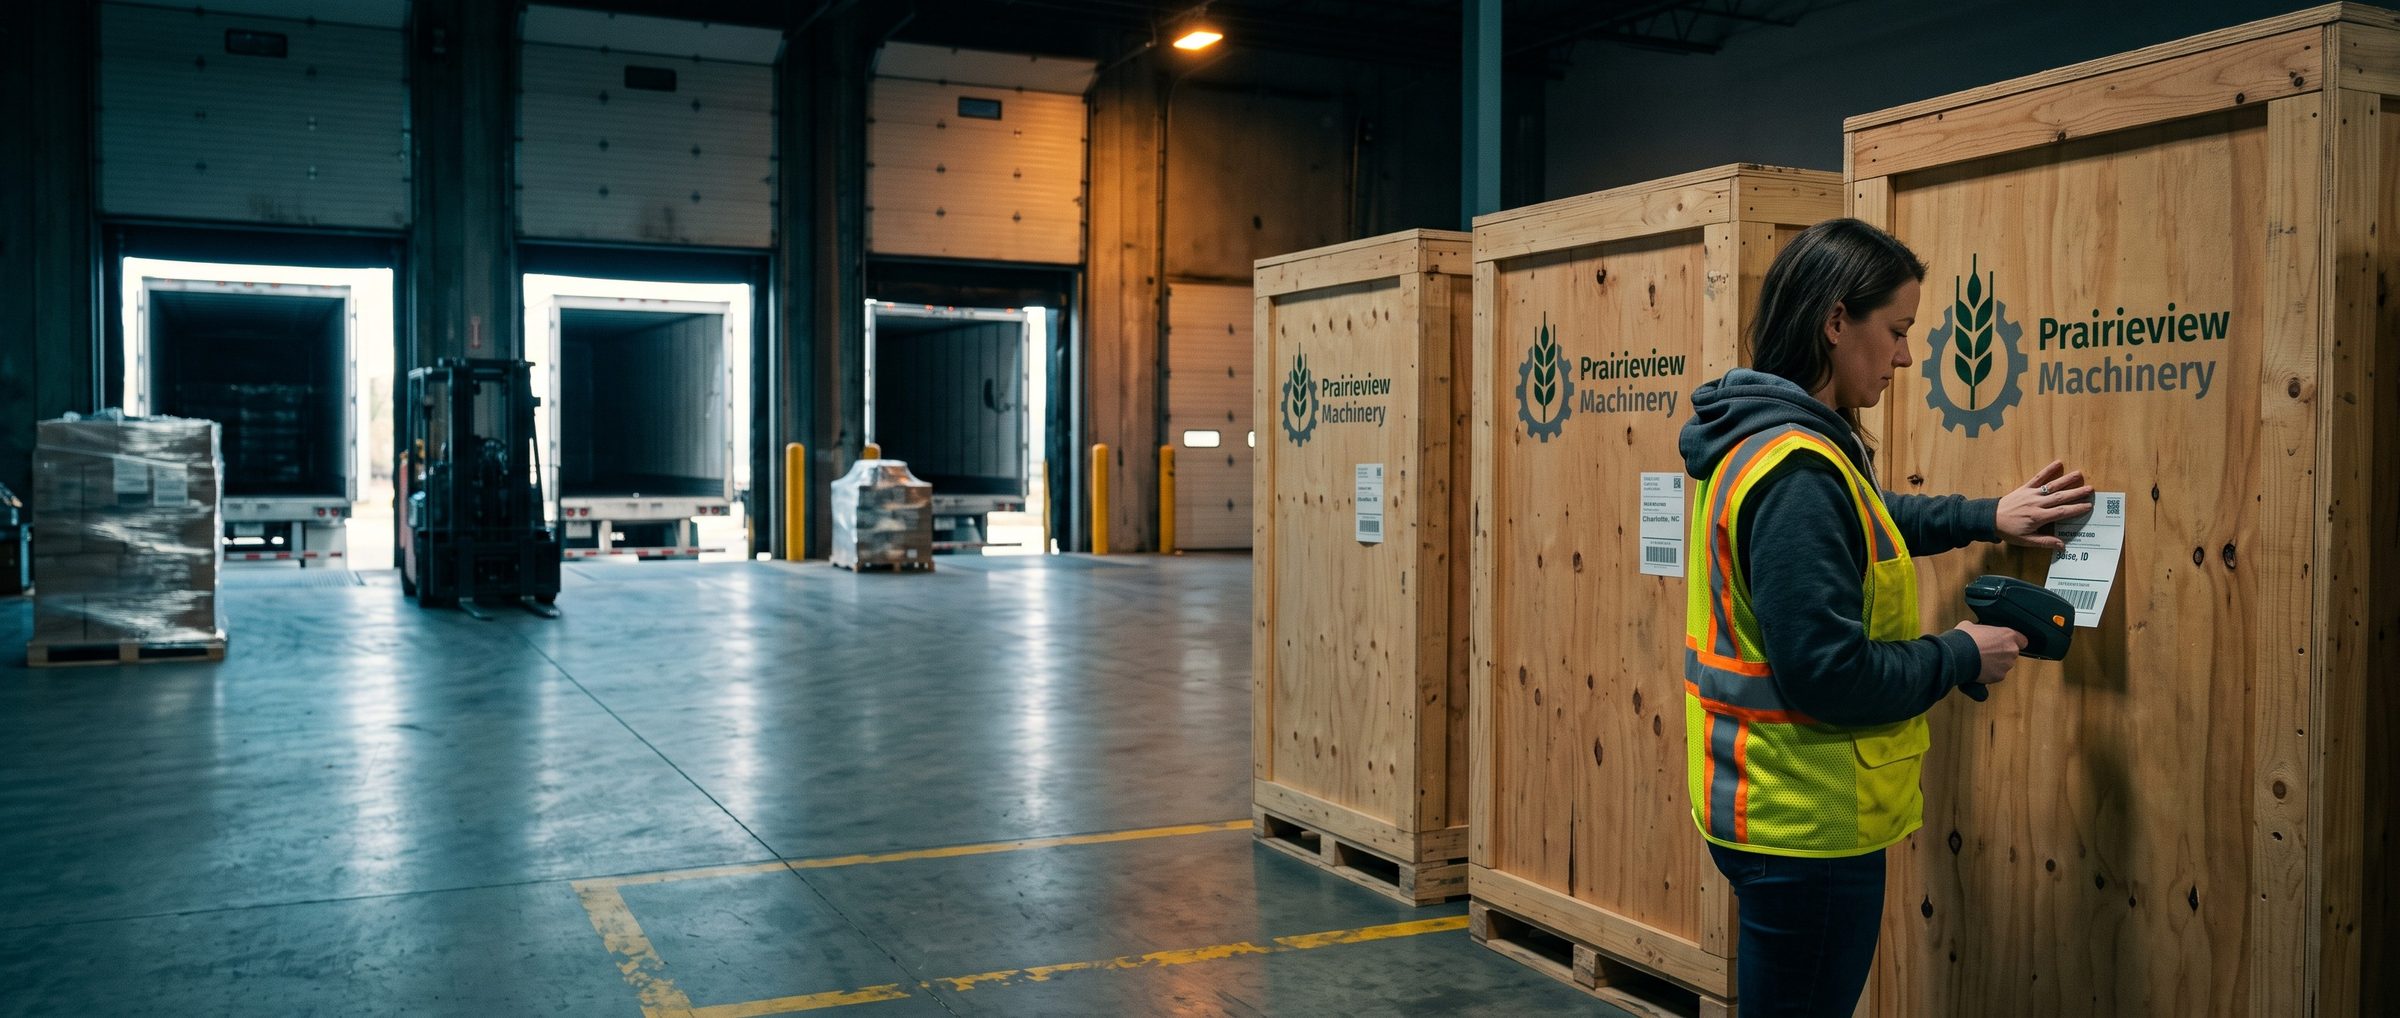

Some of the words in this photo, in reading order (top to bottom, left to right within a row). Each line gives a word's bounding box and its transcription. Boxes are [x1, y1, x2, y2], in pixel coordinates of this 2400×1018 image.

[2039, 302, 2230, 351] Prairieview
[1580, 347, 1686, 381] Prairieview
[2038, 354, 2217, 400] Machinery
[1321, 371, 1391, 399] Prairieview
[1579, 384, 1678, 419] Machinery
[1321, 399, 1387, 428] Machinery
[2080, 552, 2089, 561] ID
